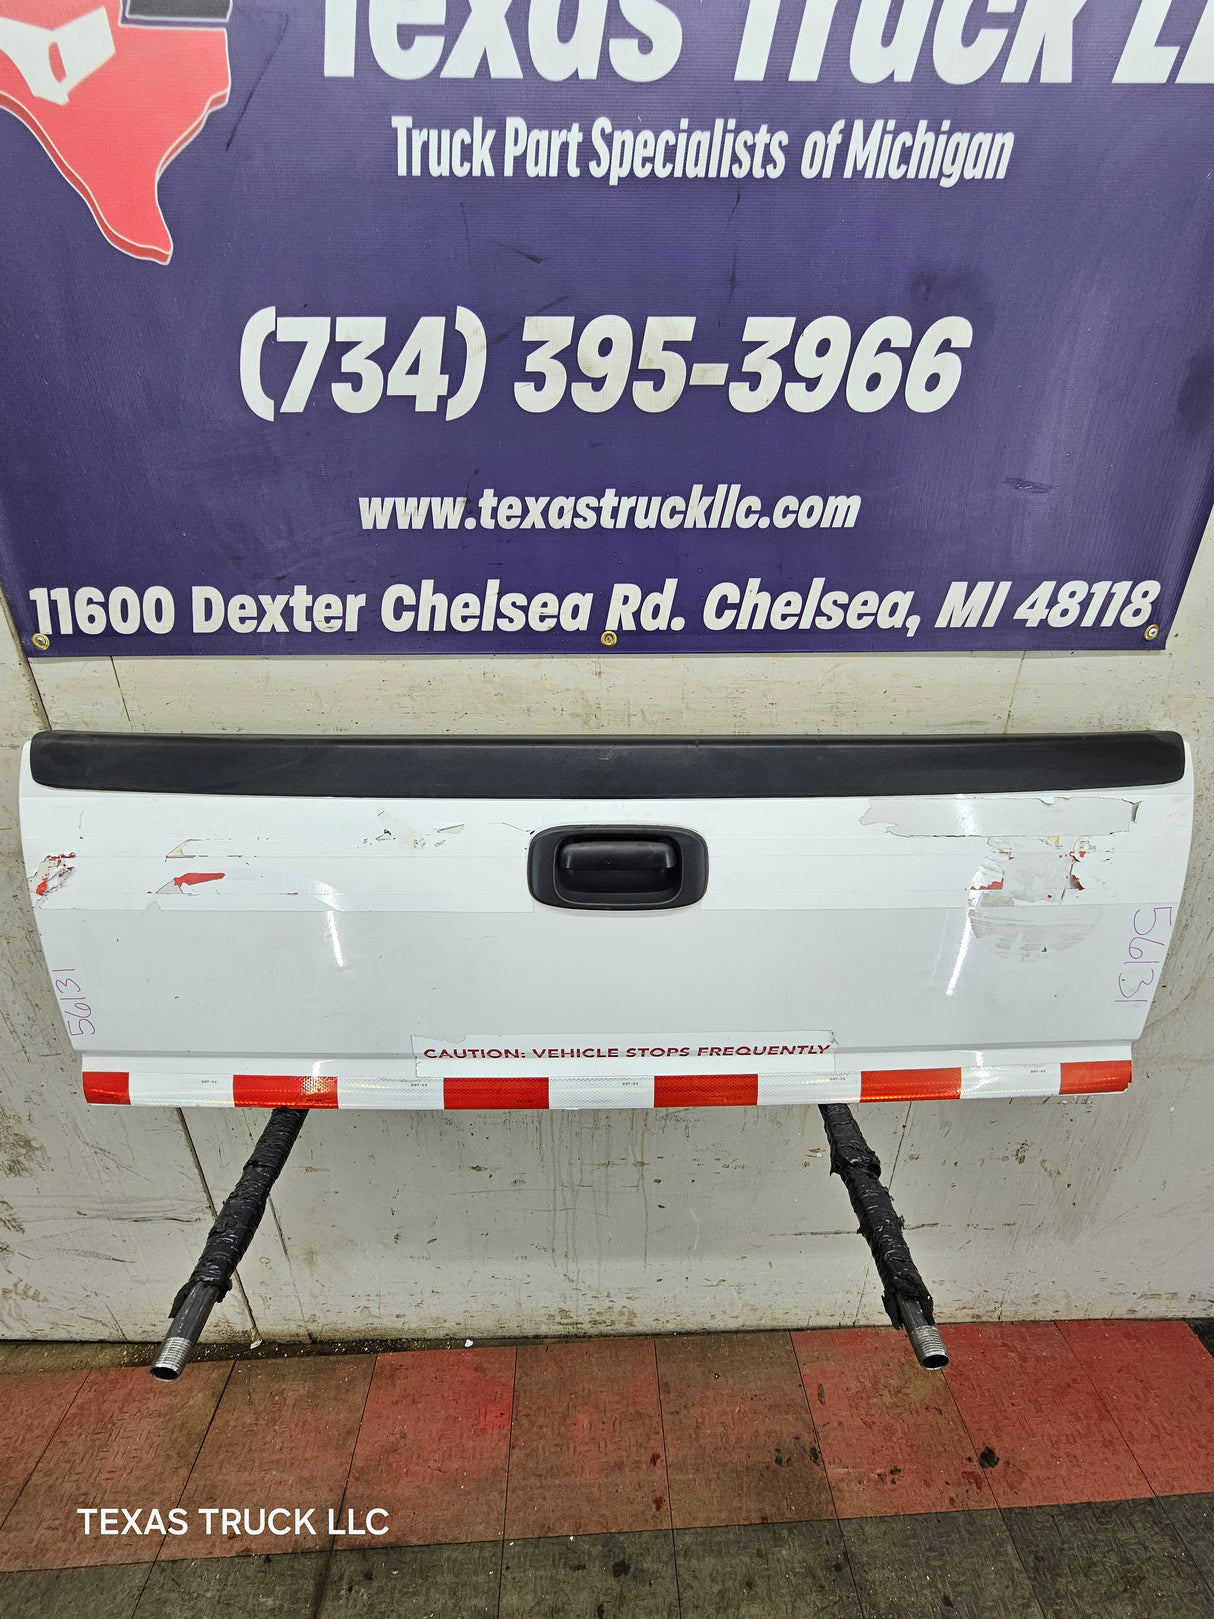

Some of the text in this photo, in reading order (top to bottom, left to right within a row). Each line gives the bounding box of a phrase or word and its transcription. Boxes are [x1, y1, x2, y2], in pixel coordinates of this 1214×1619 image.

[391, 116, 1015, 188] Truck Part Specialists of Michigan
[240, 306, 973, 421] (734) 395-3966
[359, 484, 862, 529] www.texastruckllc.com
[29, 578, 1161, 637] 11600 Dexter Chelsea Rd. Chelsea, MI 48118
[1114, 906, 1173, 1003] 56131
[52, 968, 96, 1036] 56131
[423, 1045, 831, 1059] CAUTION: VEHICLE STOPS FREQUENTLY
